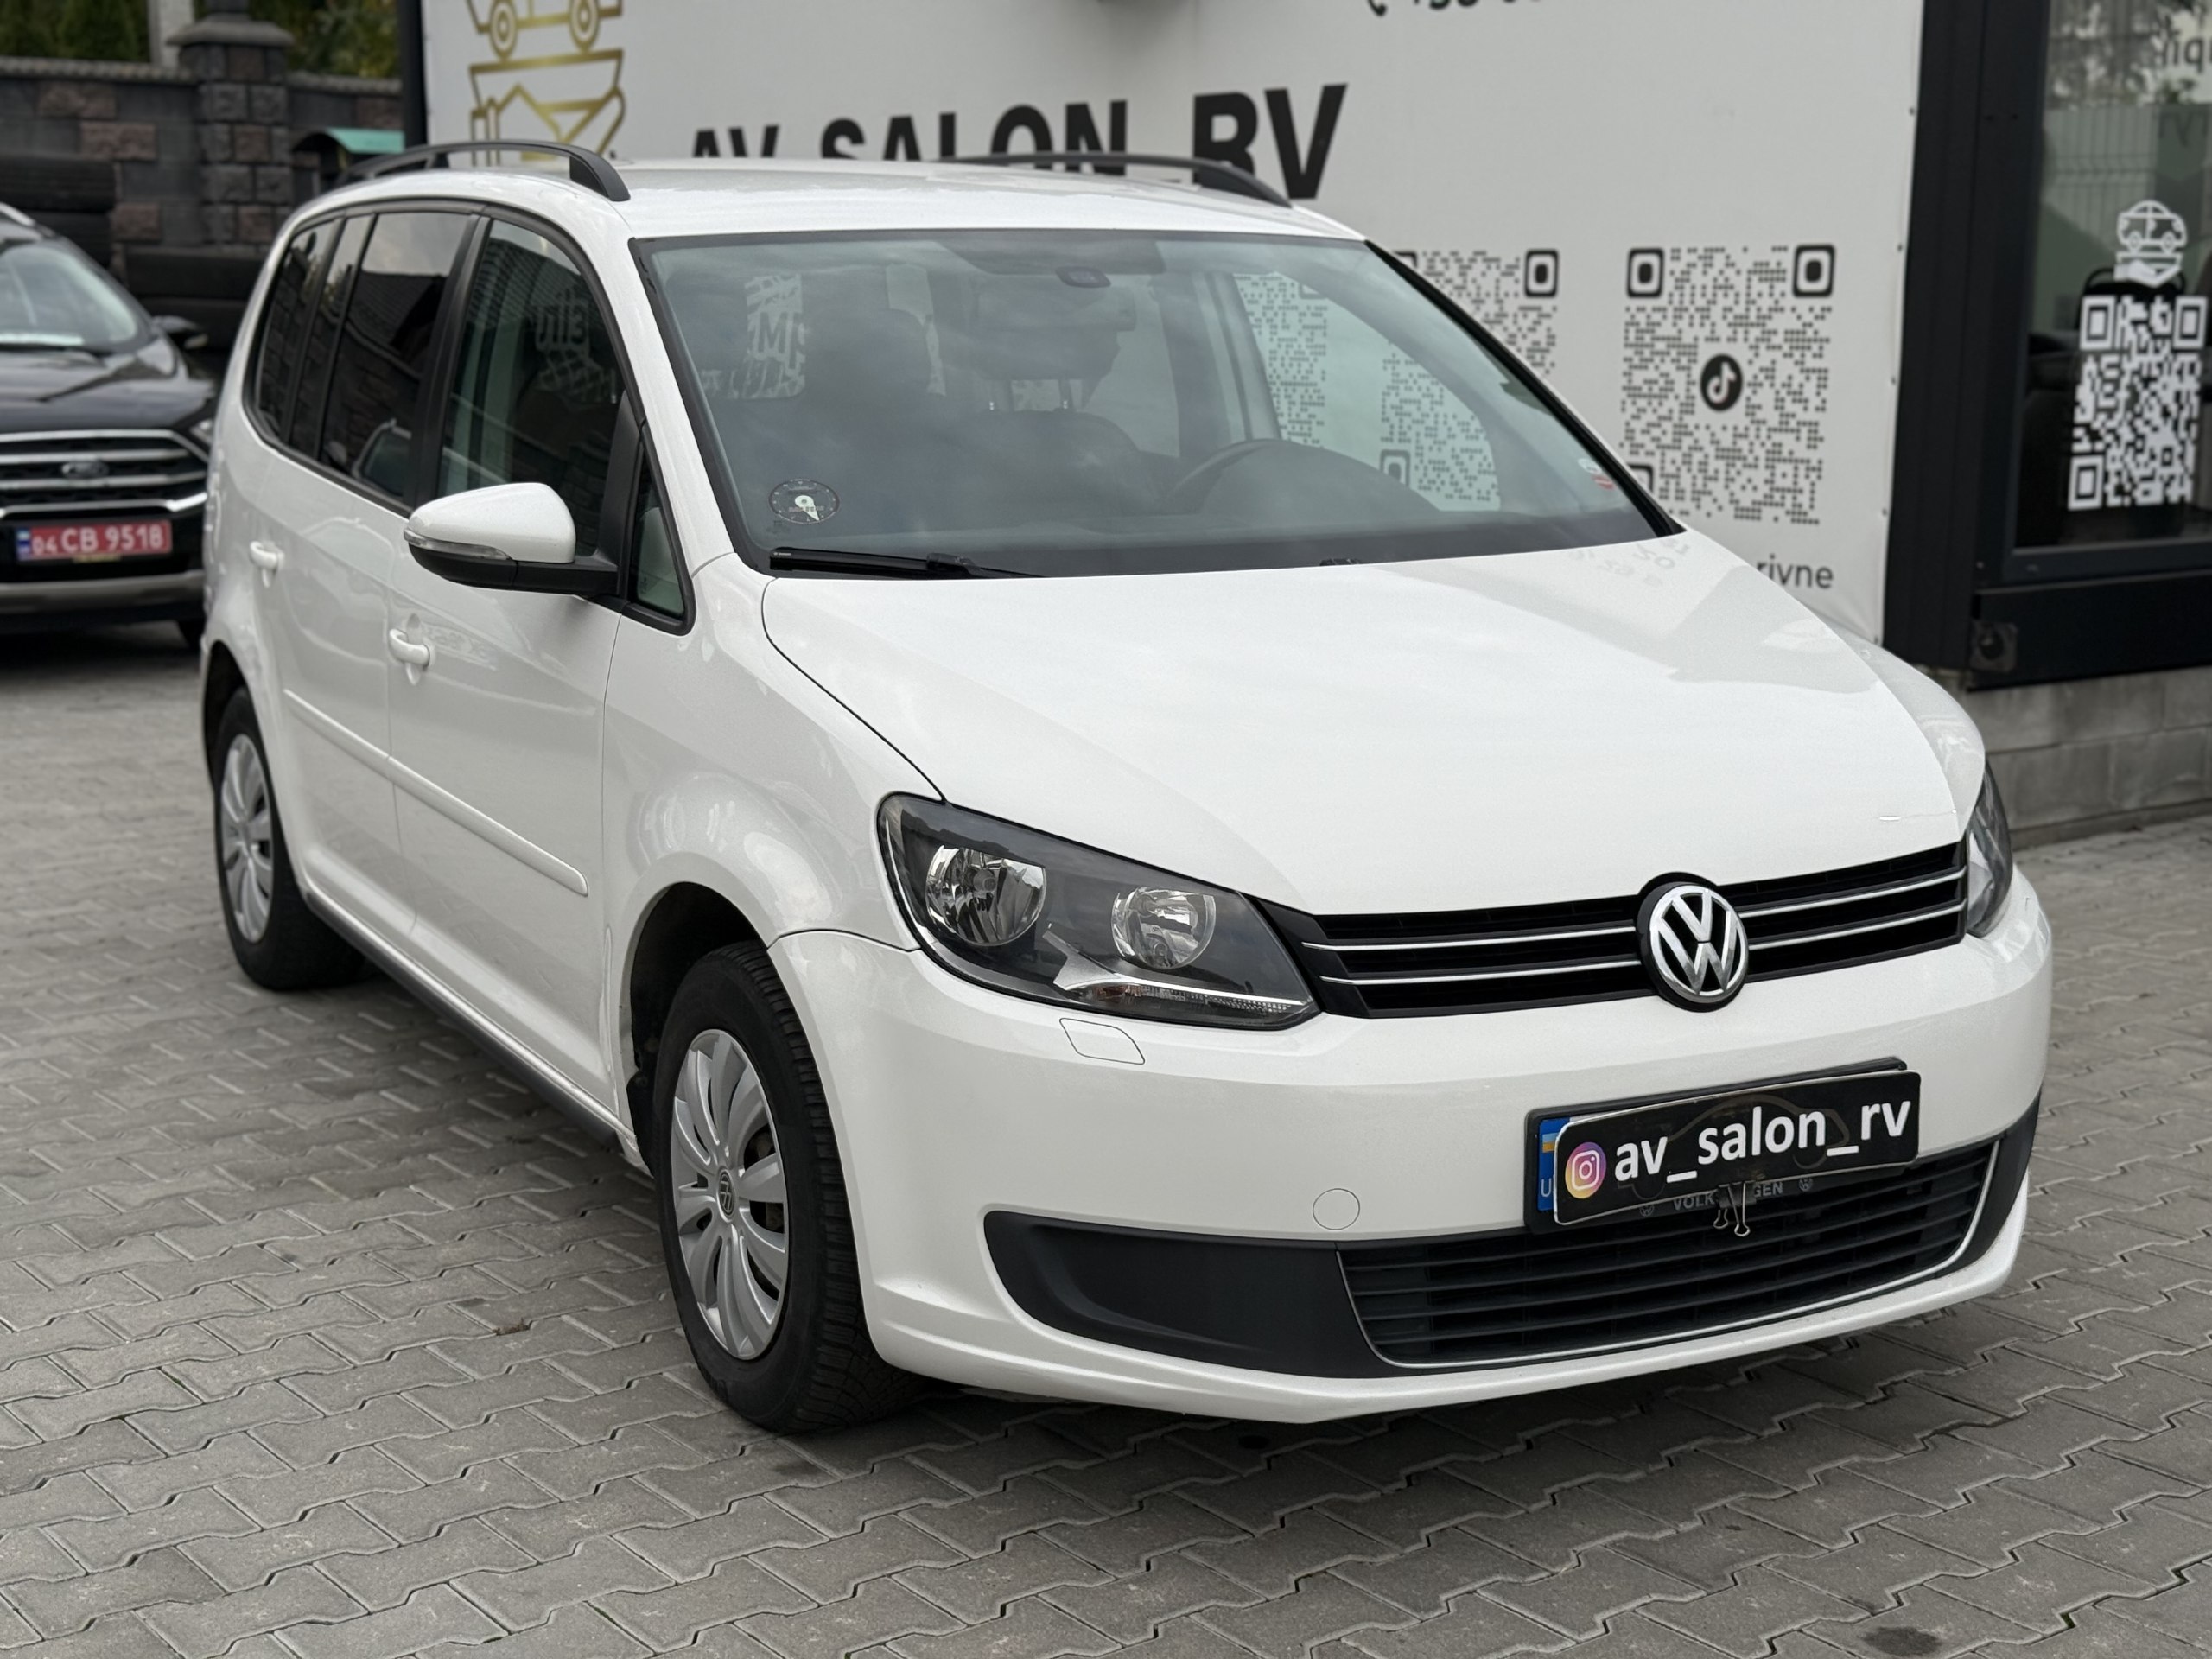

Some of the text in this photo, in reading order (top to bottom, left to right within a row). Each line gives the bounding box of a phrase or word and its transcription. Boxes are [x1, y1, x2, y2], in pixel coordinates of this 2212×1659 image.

[61, 527, 98, 553] CB
[105, 524, 162, 551] 9518
[1614, 1100, 1911, 1184] av_salon_rv
[1673, 1181, 1783, 1211] VOLKGEN
